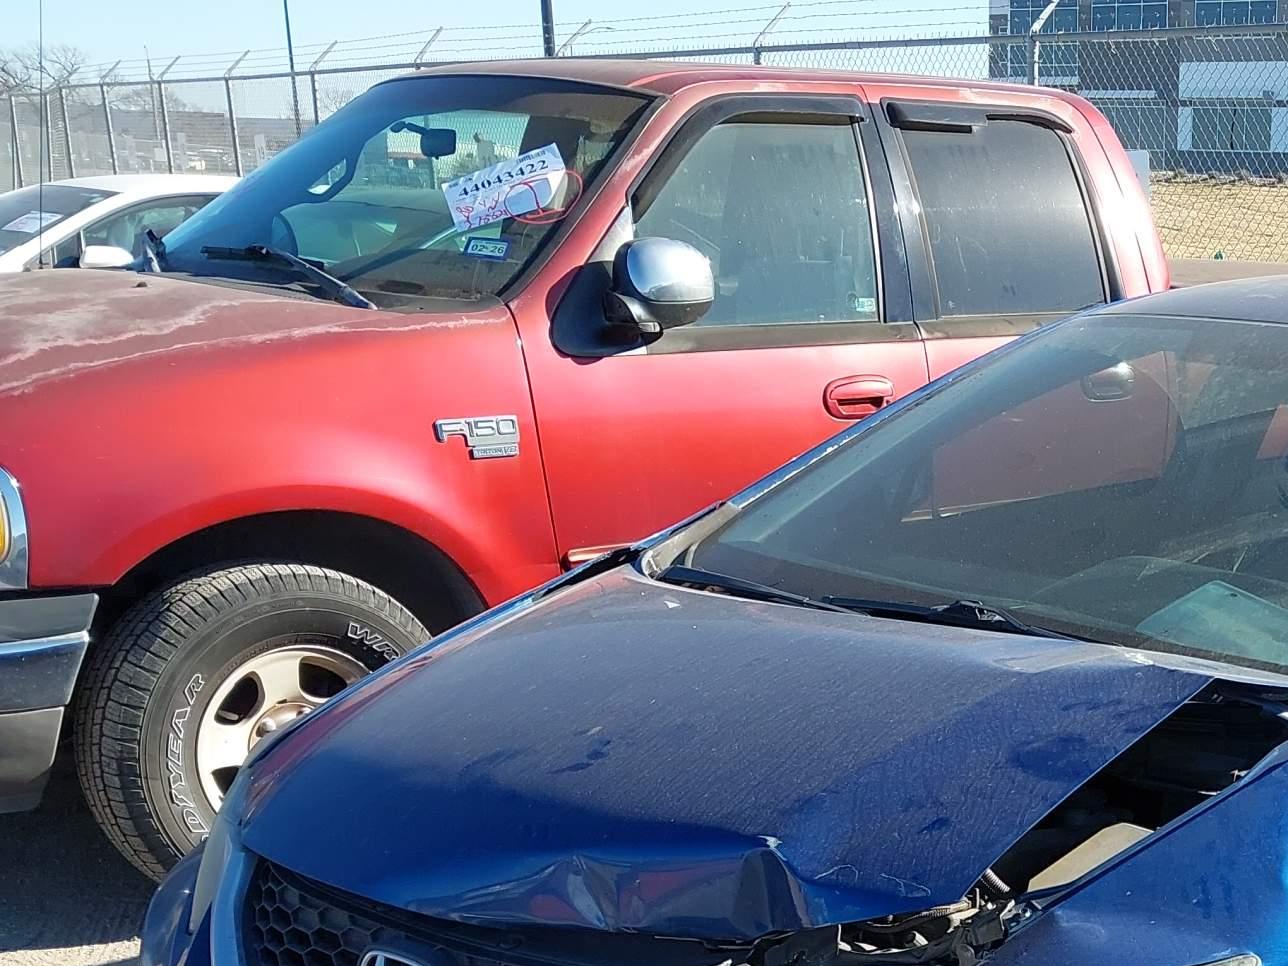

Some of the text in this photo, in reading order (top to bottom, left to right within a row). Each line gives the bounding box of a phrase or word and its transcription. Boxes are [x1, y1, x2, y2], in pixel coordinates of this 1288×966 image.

[458, 160, 549, 197] 44043422
[347, 622, 401, 661] WR
[166, 673, 209, 842] DYEAR
